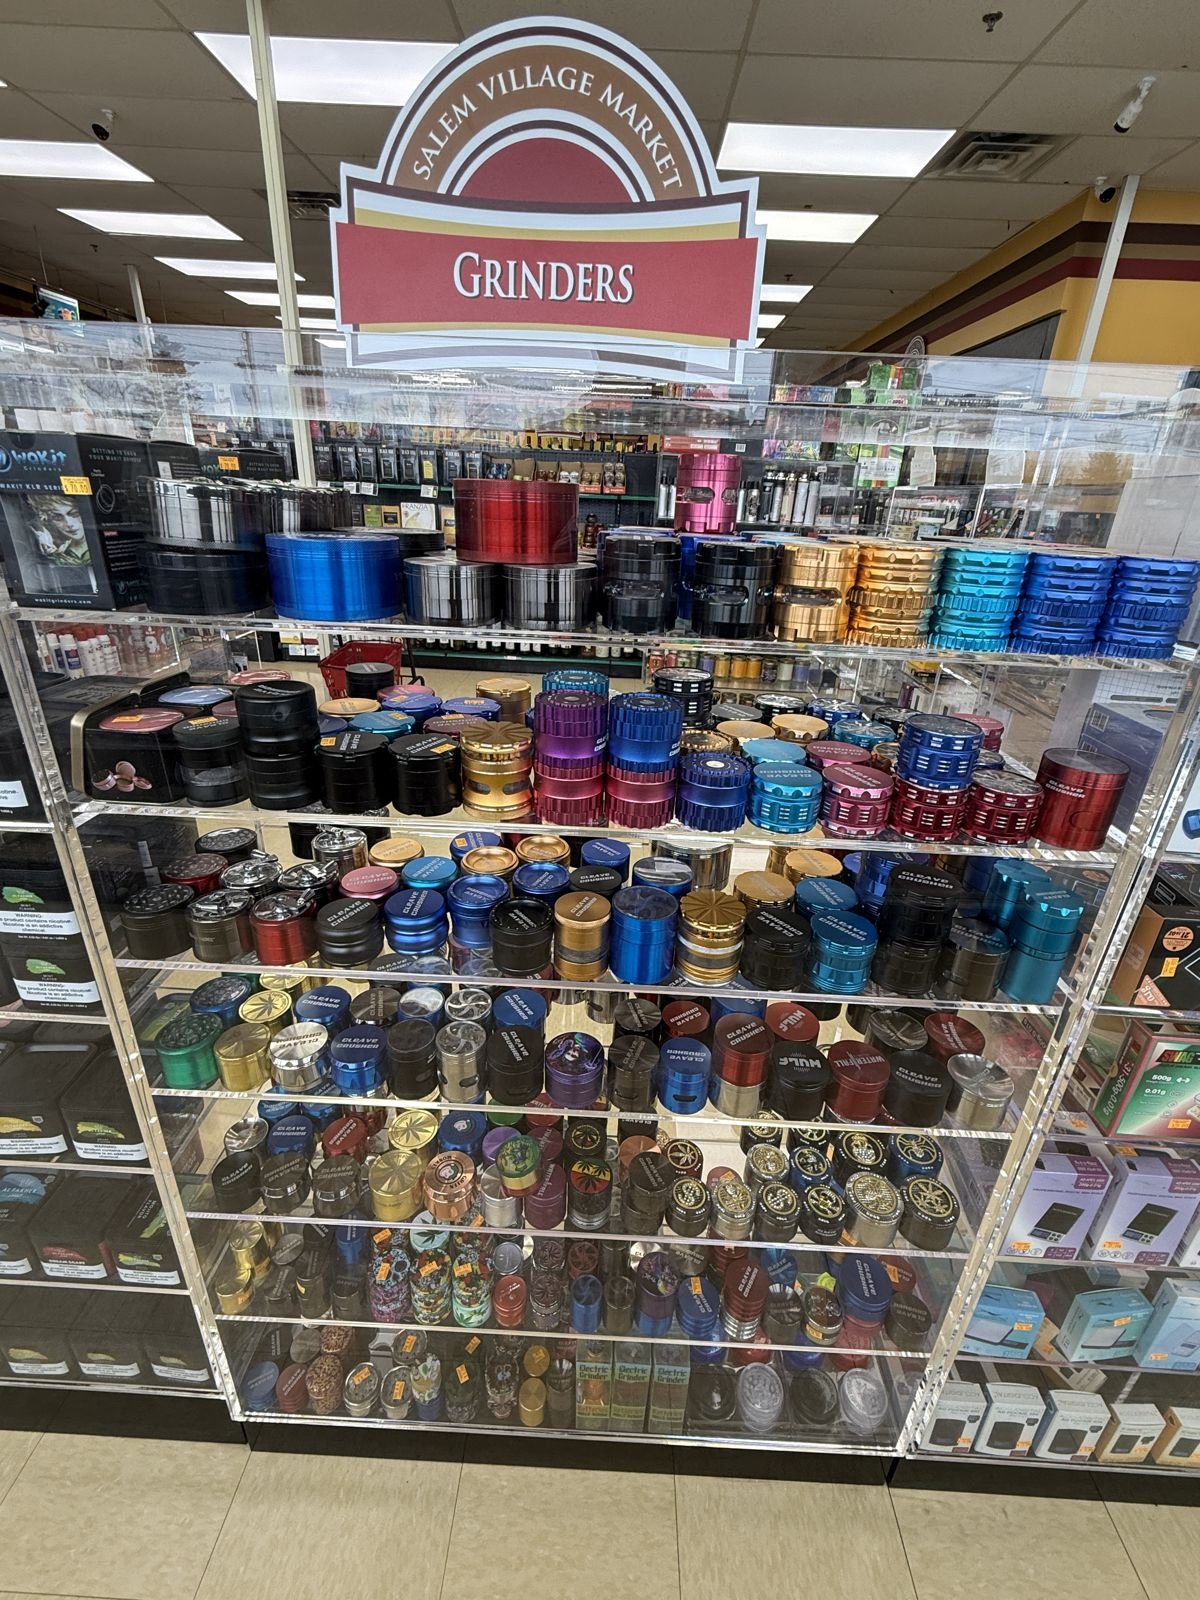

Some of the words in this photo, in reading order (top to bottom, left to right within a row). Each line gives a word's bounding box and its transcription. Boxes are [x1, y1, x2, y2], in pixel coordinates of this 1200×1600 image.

[412, 94, 478, 181] SALEM
[477, 64, 595, 101] VILLAGE
[598, 83, 683, 190] MARKET
[453, 251, 635, 305] GRINDERS
[406, 736, 438, 751] CLEAVE
[1048, 779, 1084, 792] CLEAVE
[898, 874, 953, 889] CRUSHER
[901, 871, 949, 884] CLEAVE
[327, 901, 362, 921] CLEAVE
[402, 890, 419, 914] CLEAVE
[411, 890, 428, 916] CRUSHER
[330, 902, 372, 927] CRUSHER
[760, 911, 804, 936] CRUSHER
[756, 916, 794, 937] CLEAVE
[818, 917, 866, 941] CRUSHER
[826, 915, 868, 935] CLEAVE
[308, 995, 341, 1003] CLEAVE
[504, 995, 528, 1020] CRUSHER
[513, 994, 534, 1016] CLEAVE
[676, 1012, 702, 1026] CLEAVE
[778, 1010, 806, 1032] WULF
[726, 1022, 757, 1040] CLEAVE
[729, 1026, 766, 1046] CRUSHER
[278, 1038, 319, 1049] CLEAVE
[501, 1031, 522, 1062] CRUSHER
[510, 1031, 529, 1057] CLEAVE
[778, 1057, 822, 1069] WULF
[895, 1071, 942, 1088] CRUSHER
[898, 1067, 938, 1081] CLEAVE
[336, 1122, 357, 1146] CLEAVE
[863, 1263, 877, 1296] CLEAVE
[579, 1364, 609, 1374] Electric
[579, 1372, 607, 1380] Grinder
[618, 1365, 649, 1375] Electric
[618, 1373, 648, 1381] Grinder
[657, 1366, 688, 1377] Electric
[657, 1375, 687, 1384] Grinder
